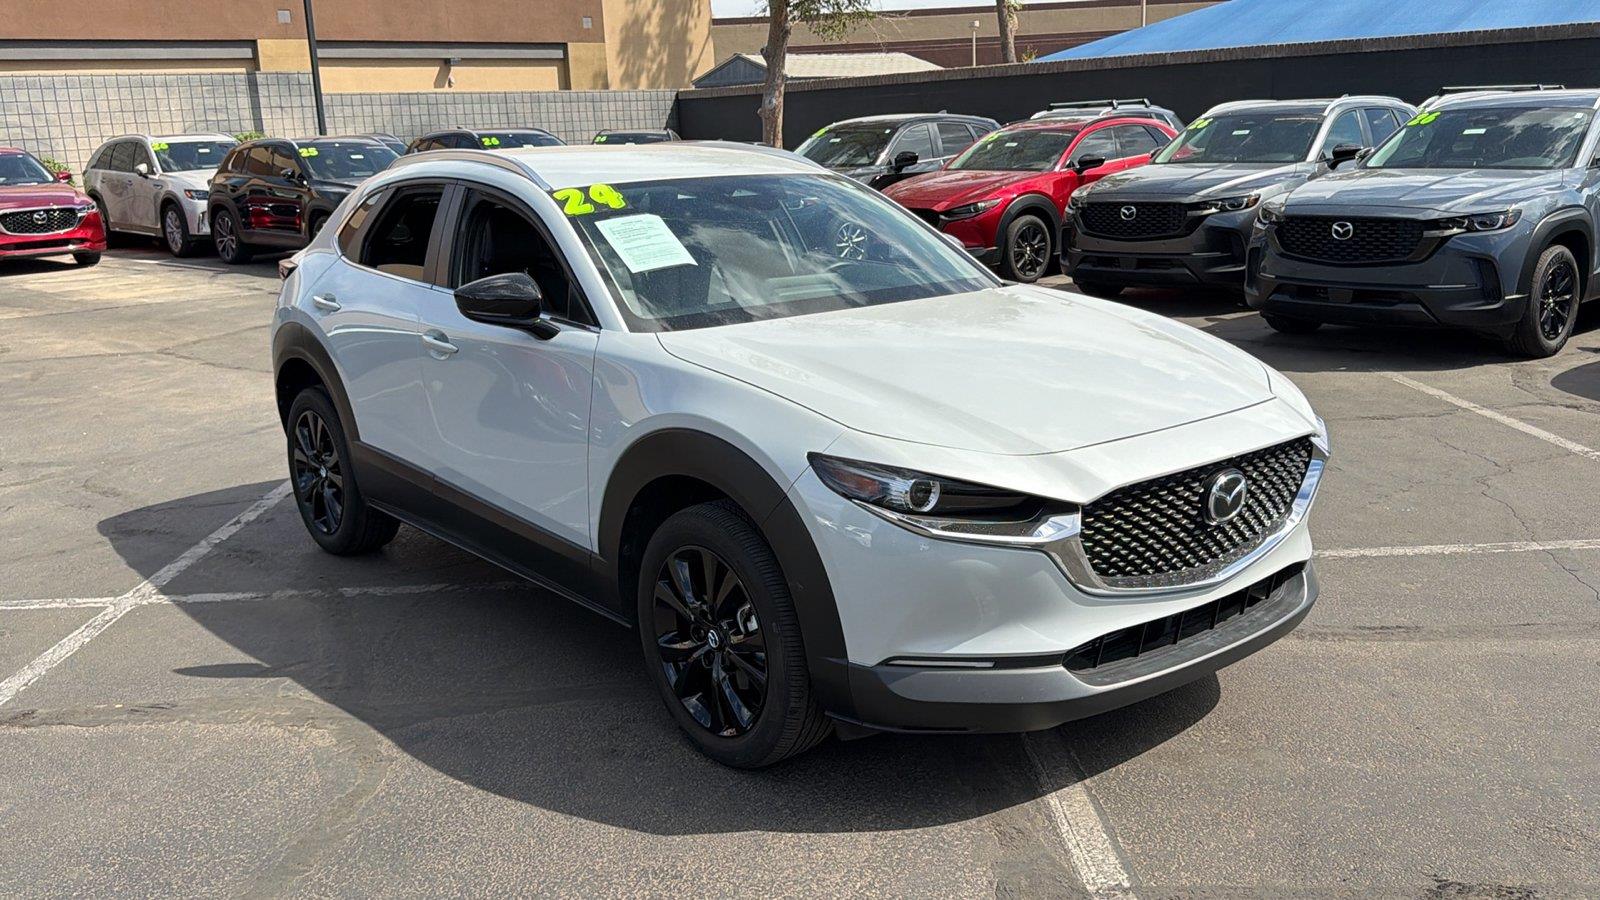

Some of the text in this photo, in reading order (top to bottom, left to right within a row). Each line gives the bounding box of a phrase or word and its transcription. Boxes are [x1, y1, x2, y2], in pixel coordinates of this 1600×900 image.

[1407, 112, 1441, 126] 26
[298, 148, 318, 157] 25
[552, 183, 626, 216] 24
